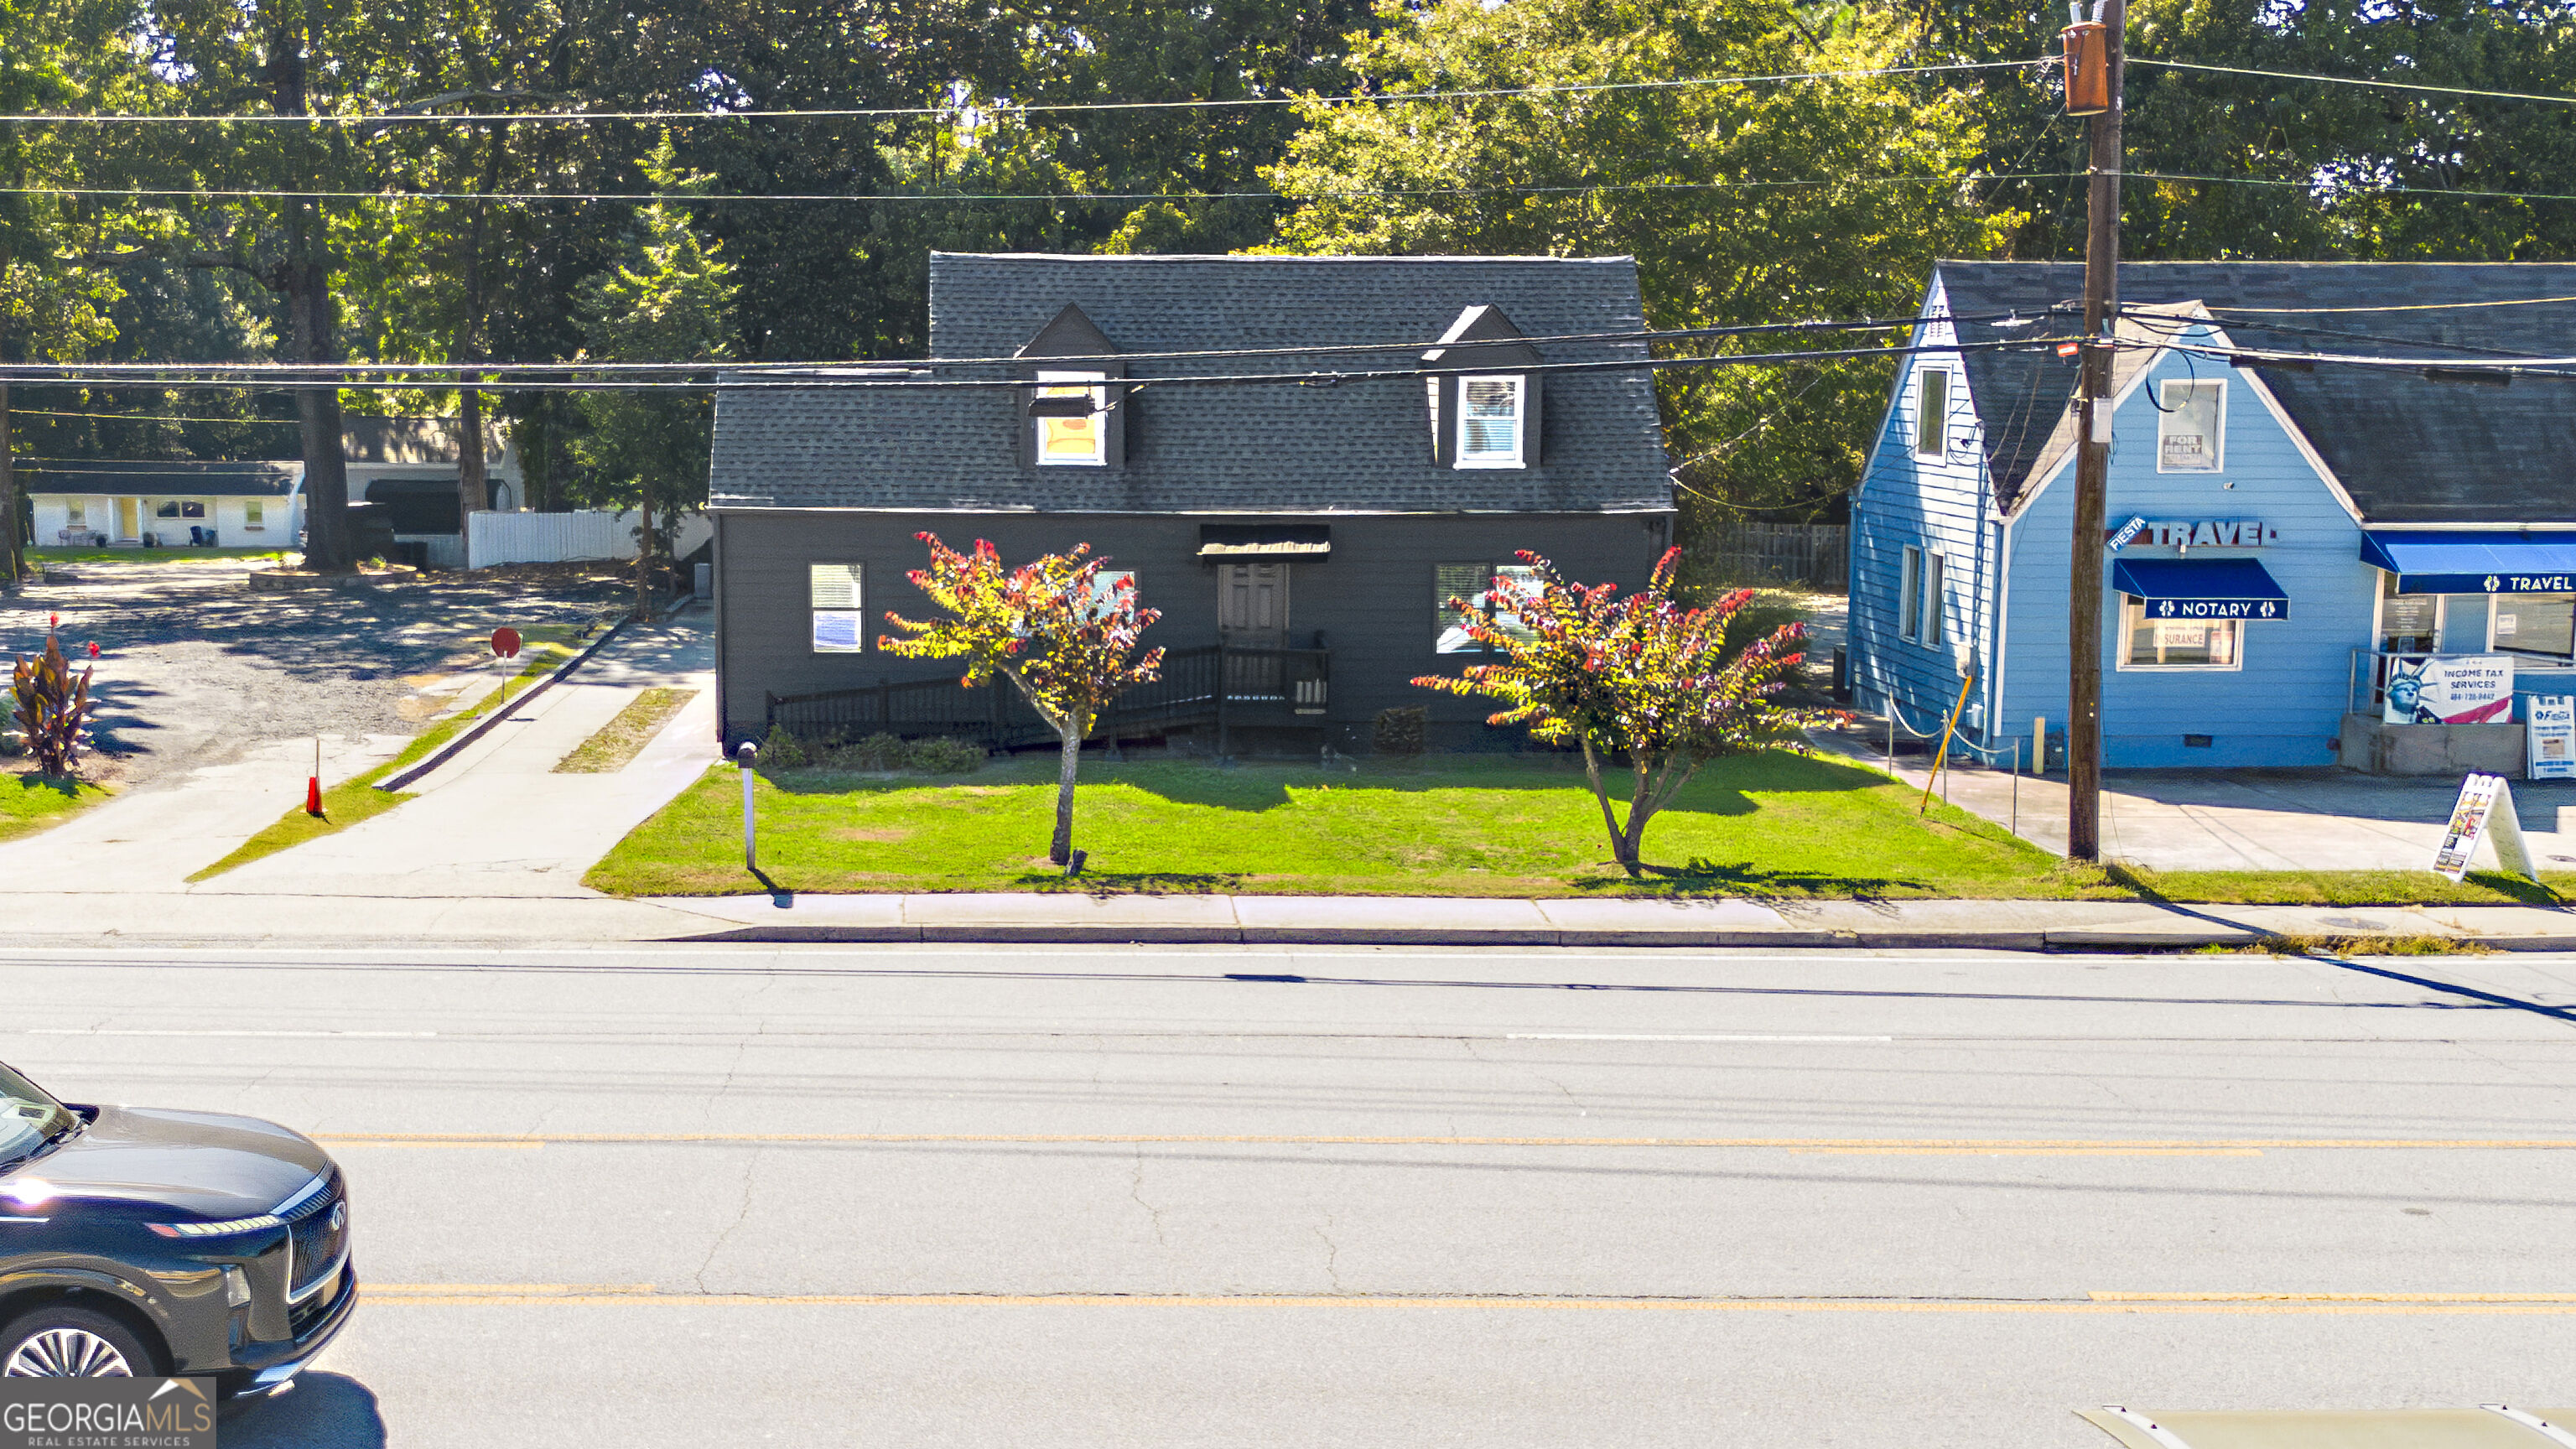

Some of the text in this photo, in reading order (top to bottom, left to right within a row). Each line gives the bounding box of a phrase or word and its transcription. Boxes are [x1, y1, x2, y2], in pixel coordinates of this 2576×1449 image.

[2168, 436, 2197, 444] FOR
[2164, 444, 2201, 454] RENT
[2109, 517, 2147, 552] FIESTA
[2510, 576, 2573, 591] TRAVEL
[2182, 602, 2251, 616] NOTARY
[2444, 669, 2504, 678] INCOME TAX
[2450, 680, 2496, 689] SERVICES
